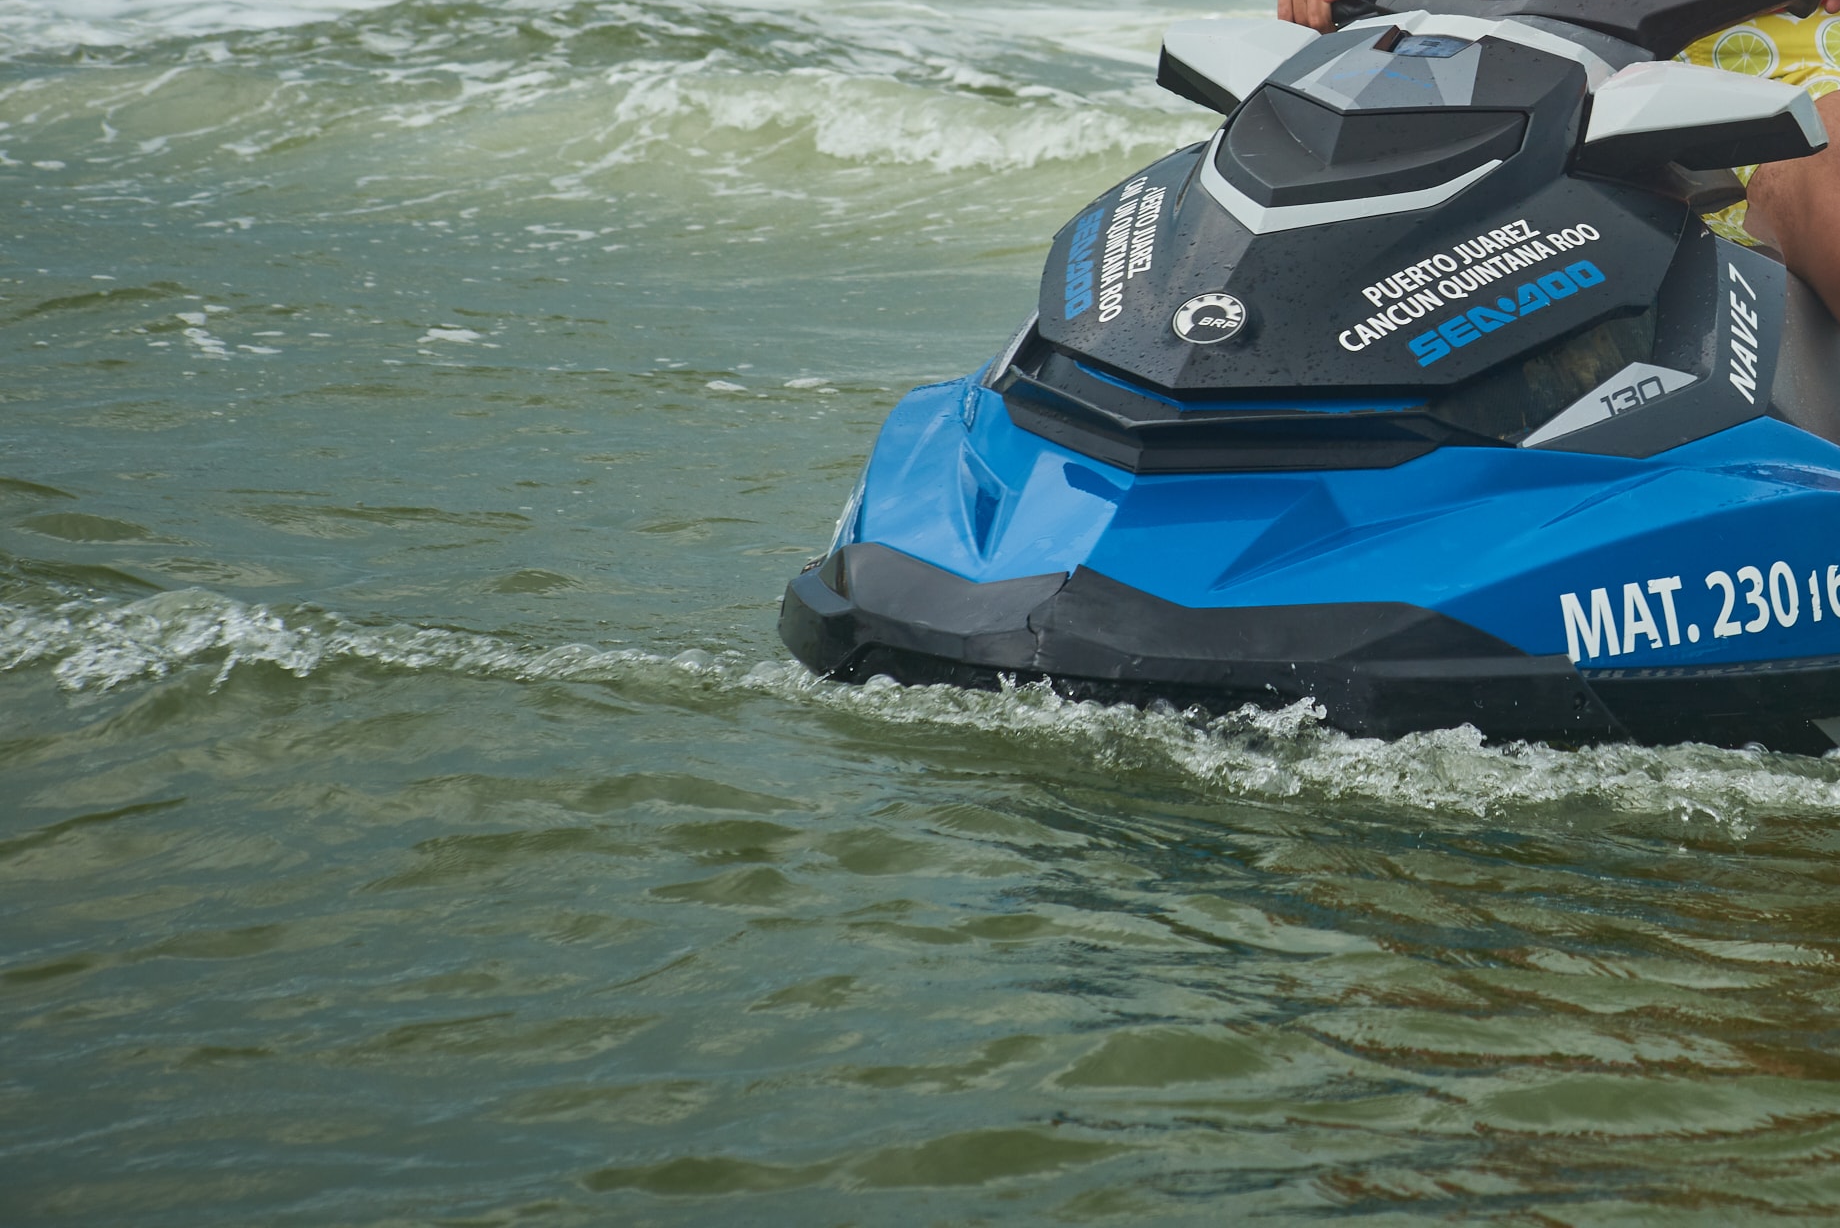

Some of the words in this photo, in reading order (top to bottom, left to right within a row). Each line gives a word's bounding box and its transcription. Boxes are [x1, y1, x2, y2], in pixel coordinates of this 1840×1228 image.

[1127, 225, 1157, 279] JUAREZ
[1361, 254, 1458, 308] PUERTO
[1453, 219, 1541, 265] JUAREZ
[1098, 282, 1124, 322] ROO
[1338, 289, 1445, 352] CANCUN
[1438, 240, 1558, 300] QUINTANA
[1546, 223, 1601, 252] ROO
[1728, 262, 1757, 301] 7
[1198, 316, 1239, 329] BRP
[1729, 290, 1758, 405] NAVE
[1600, 375, 1667, 417] 130
[1560, 575, 1701, 663] MAT.
